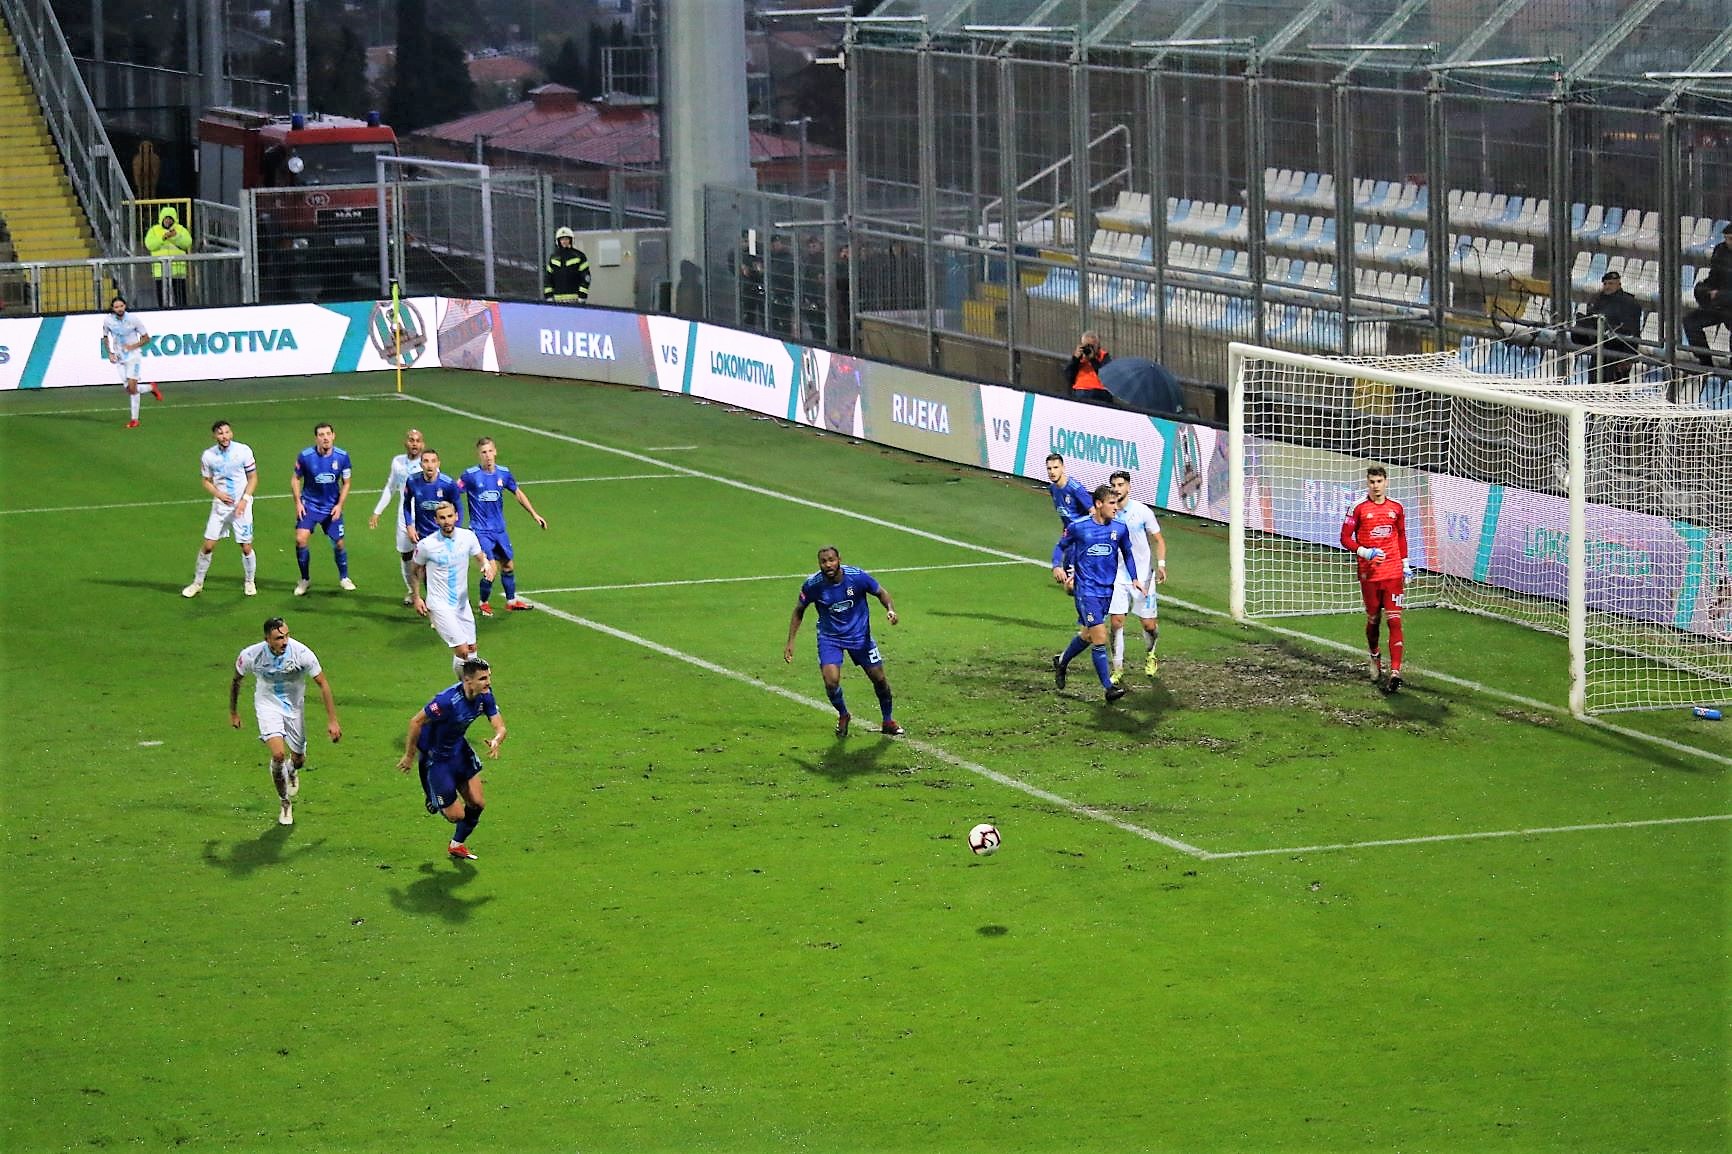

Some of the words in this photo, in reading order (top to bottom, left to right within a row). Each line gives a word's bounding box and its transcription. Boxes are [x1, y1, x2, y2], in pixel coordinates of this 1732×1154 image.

[100, 328, 299, 359] LKOMOTIVA
[538, 328, 616, 361] RIJEKA
[660, 344, 679, 365] VS
[710, 350, 776, 389] LOKOMOTIVA
[891, 393, 950, 434] RIJEKA
[992, 417, 1011, 443] VS
[1049, 426, 1140, 472] LOKOMOTIVA
[338, 525, 345, 537] 5
[1444, 511, 1471, 542] VS
